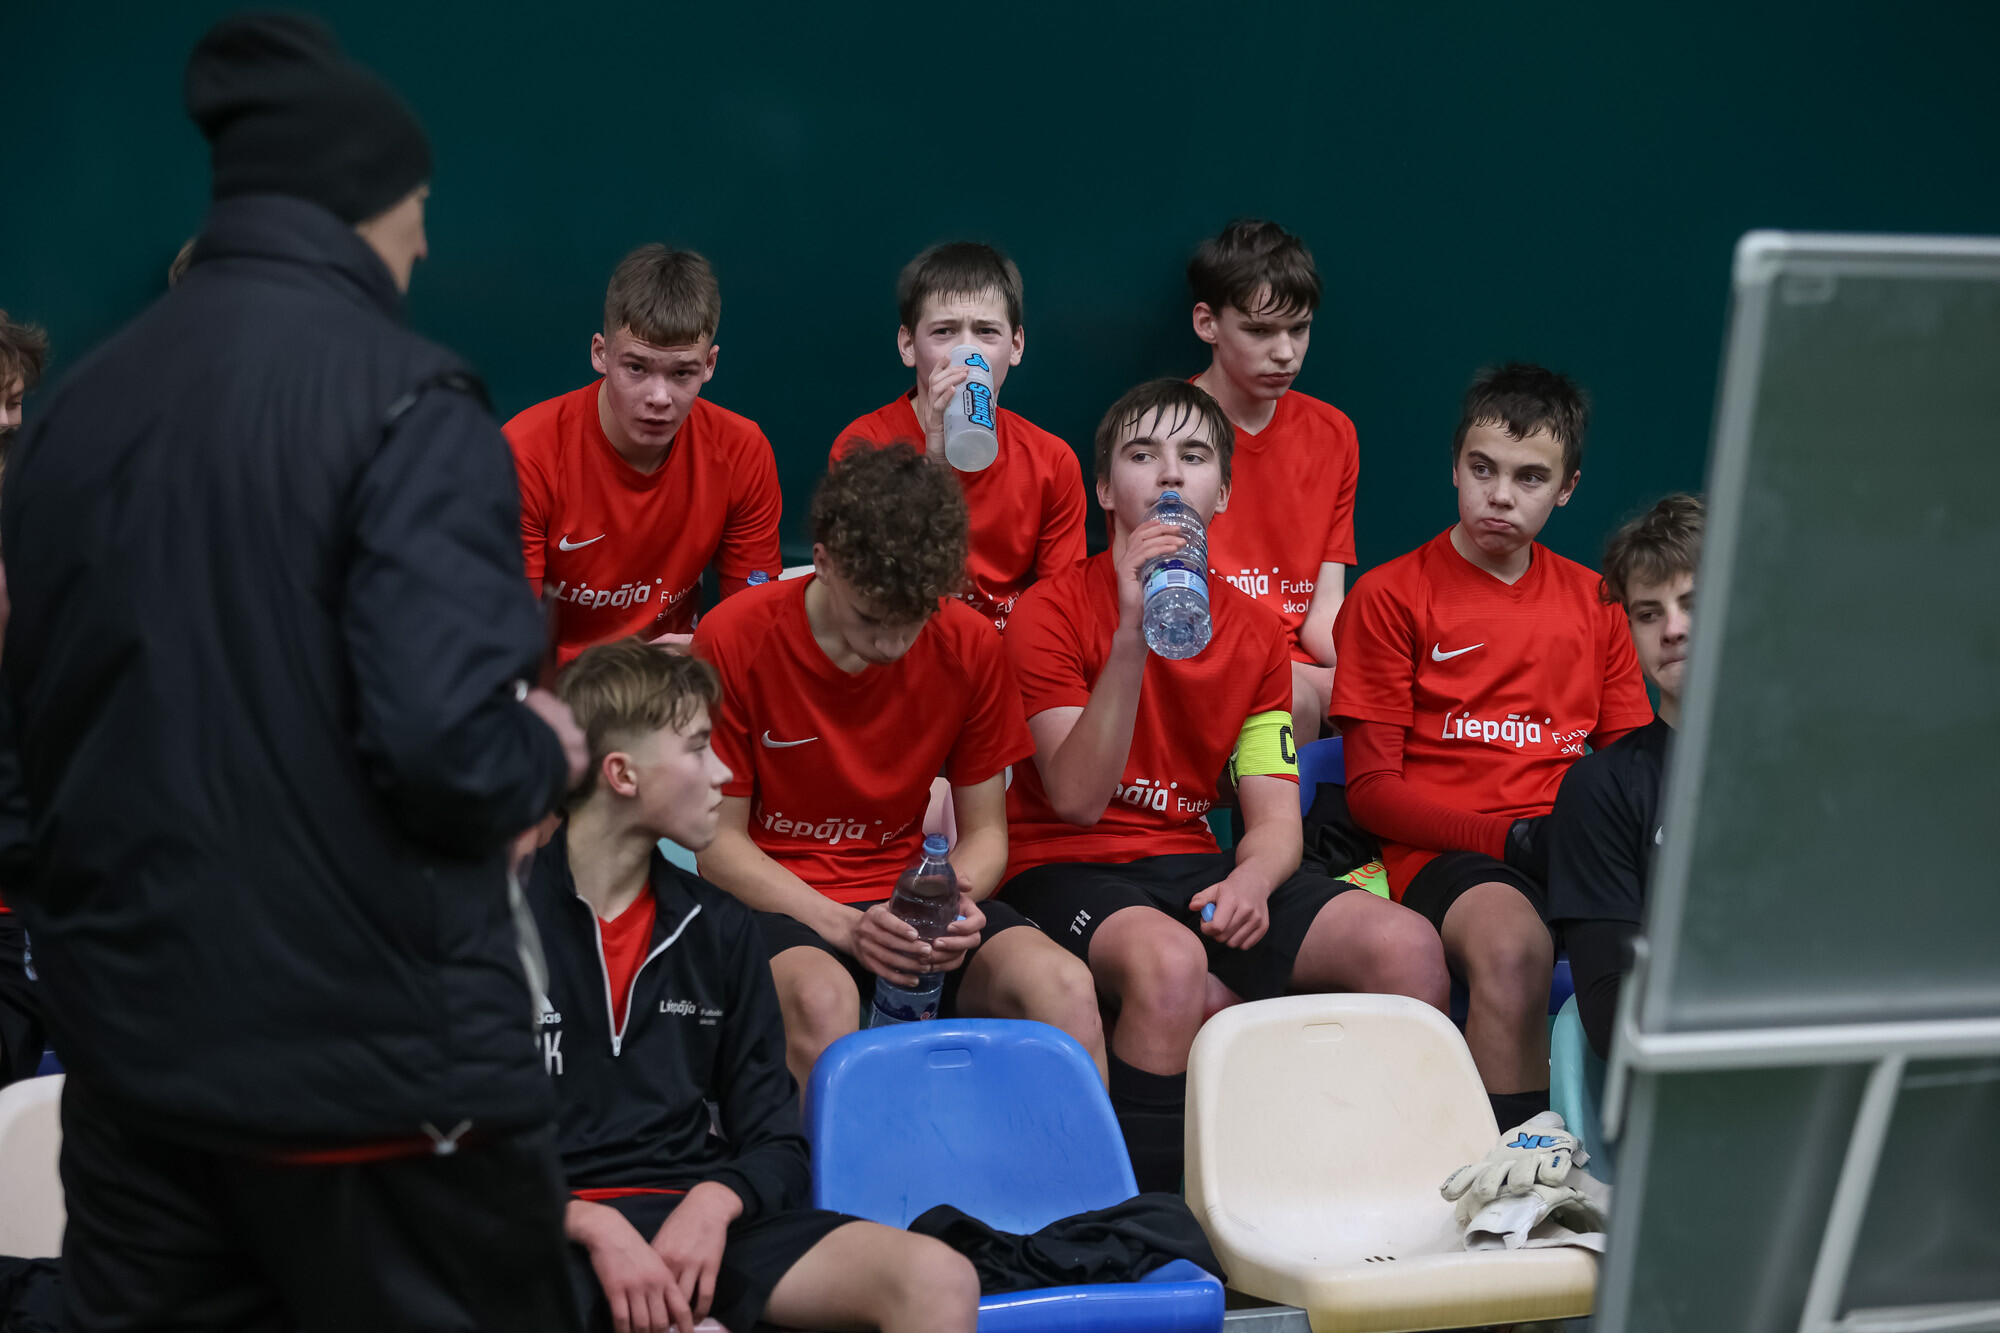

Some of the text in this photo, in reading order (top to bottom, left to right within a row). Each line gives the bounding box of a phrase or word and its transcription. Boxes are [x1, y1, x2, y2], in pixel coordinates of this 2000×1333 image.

[1280, 725, 1296, 765] C
[1442, 711, 1541, 748] Liepāja
[757, 803, 867, 845] iepāja
[1070, 909, 1092, 935] TH
